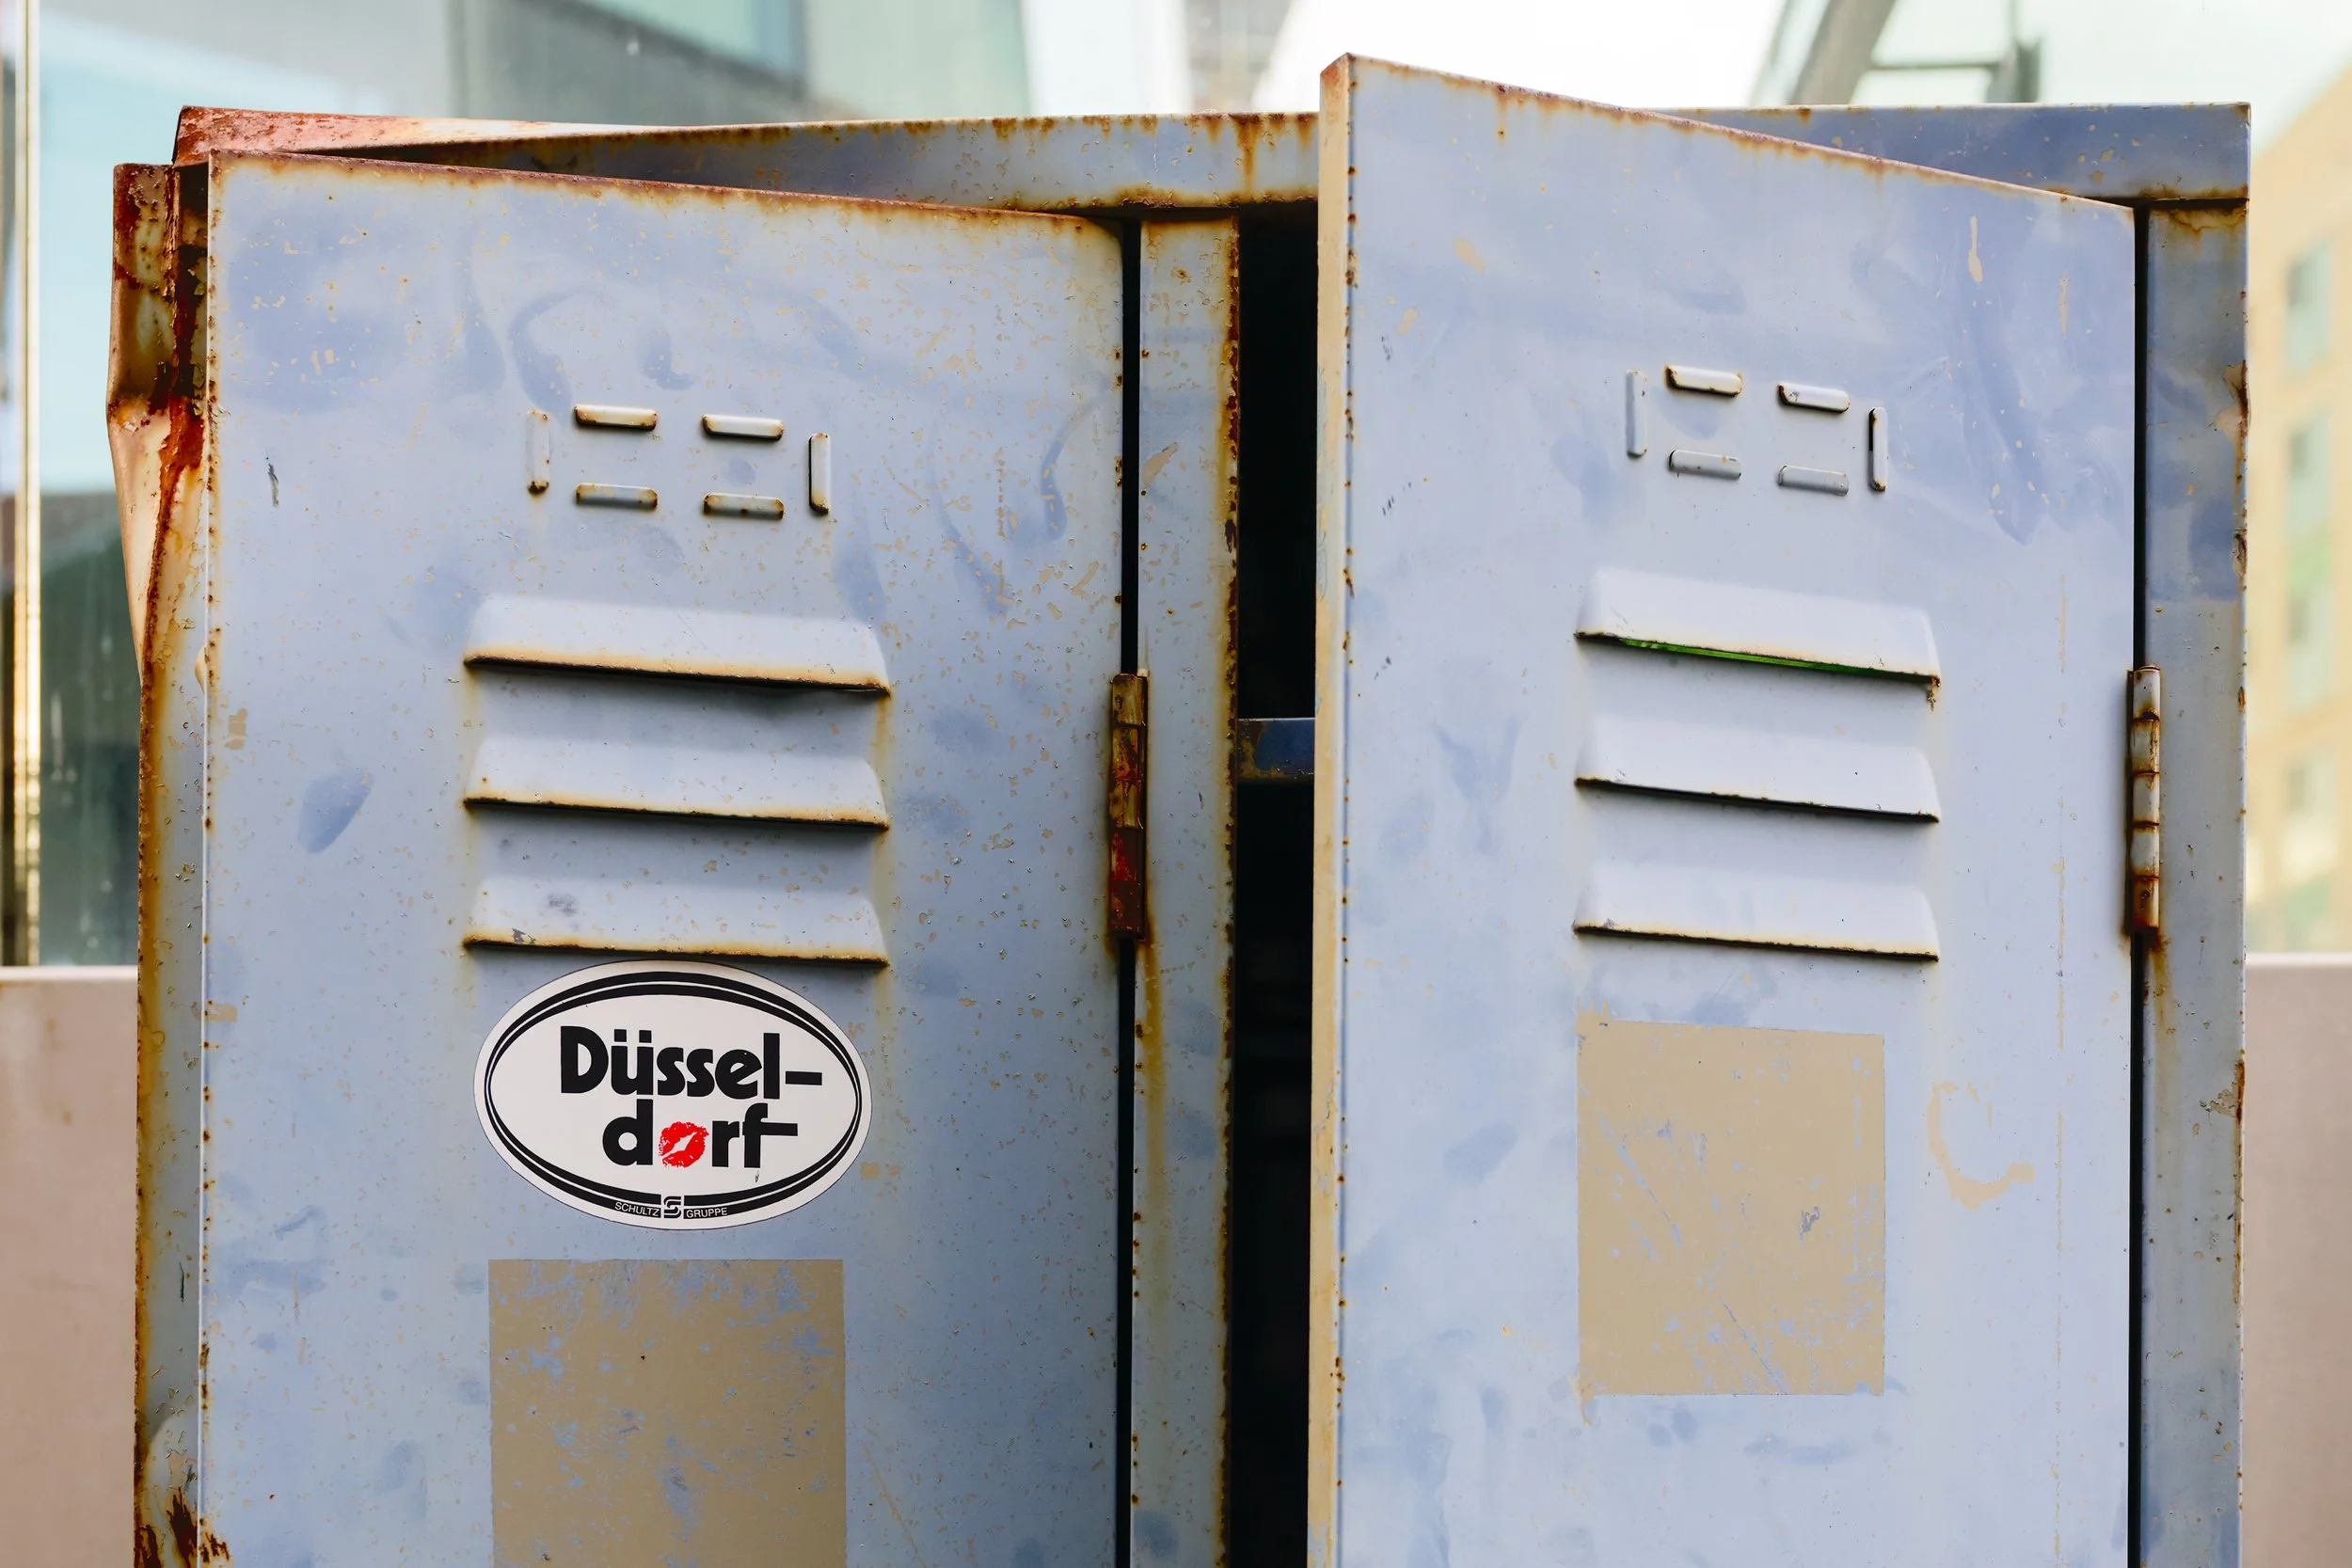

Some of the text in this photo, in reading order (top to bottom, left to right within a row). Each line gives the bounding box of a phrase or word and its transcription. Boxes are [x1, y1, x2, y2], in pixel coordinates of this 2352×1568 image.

[560, 1025, 823, 1100] Düssel-
[614, 1201, 660, 1217] SCHULTZ
[686, 1207, 728, 1218] GRUPPE
